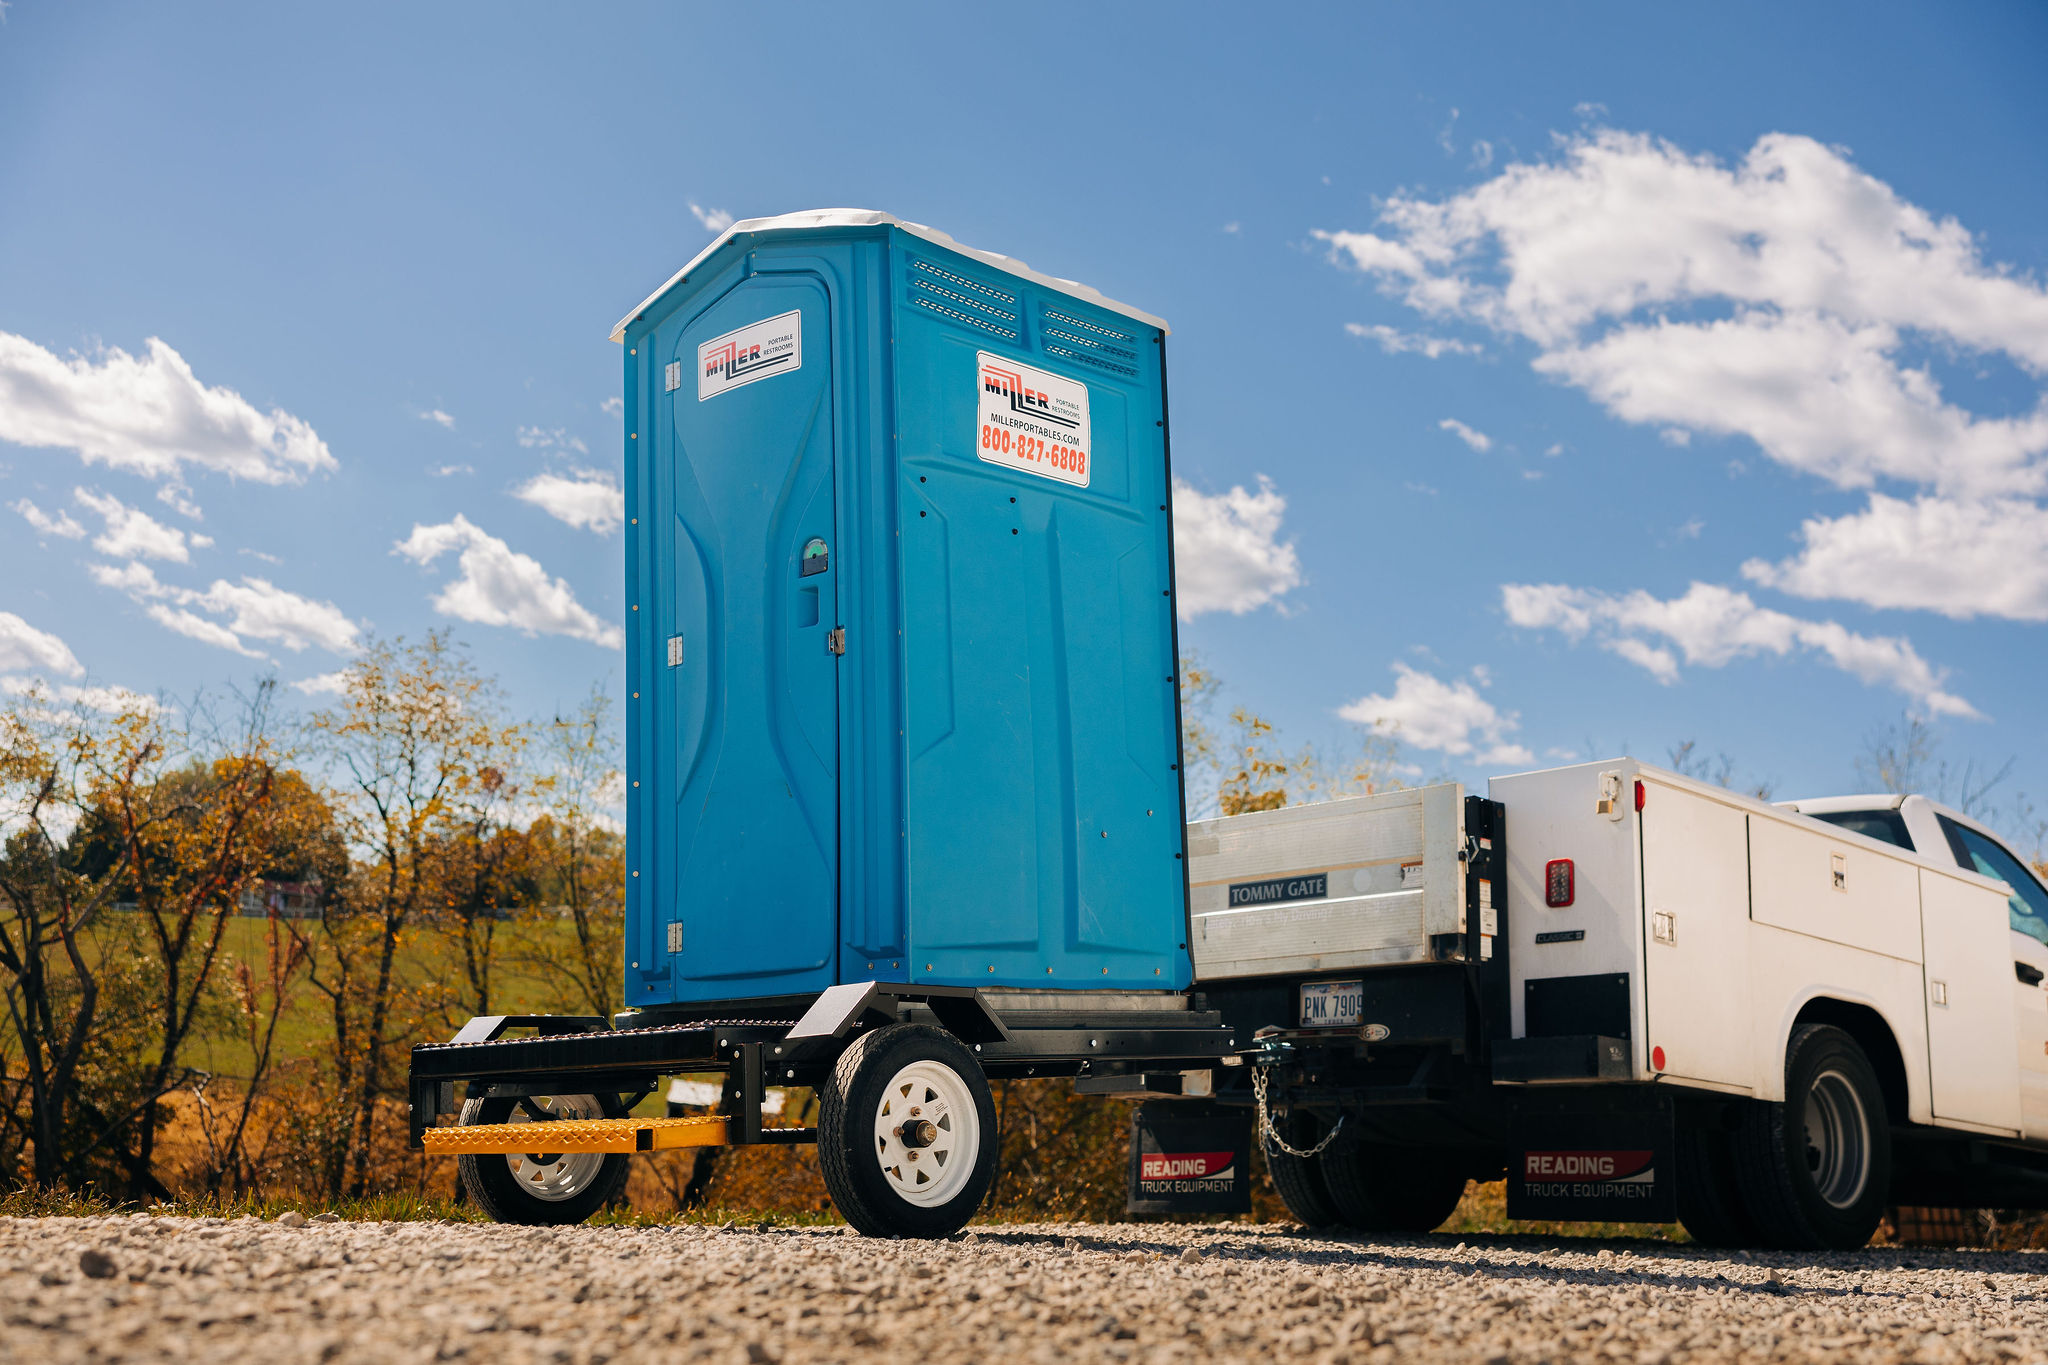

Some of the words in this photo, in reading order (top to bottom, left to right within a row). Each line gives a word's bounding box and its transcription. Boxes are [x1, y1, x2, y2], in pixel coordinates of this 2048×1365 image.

[763, 342, 793, 355] RESTROOMS
[768, 334, 793, 346] PORTABLE
[705, 341, 761, 381] MILLER
[984, 374, 1050, 411] MILLER
[1051, 405, 1080, 419] RESTROOMS
[1055, 398, 1080, 411] PORTABLE
[990, 413, 1080, 446] MILLERPORTABLES.COM
[982, 424, 1086, 475] 800-827-6808
[1232, 883, 1284, 903] TOMMY
[1288, 879, 1324, 896] GATE
[1304, 996, 1327, 1018] PNK
[1333, 994, 1363, 1017] 7909
[1142, 1158, 1207, 1178] READING
[1527, 1156, 1614, 1175] READING
[1140, 1180, 1173, 1193] TRUCK
[1175, 1180, 1235, 1193] EQUIPMENT
[1525, 1183, 1570, 1197] TRUCK
[1573, 1184, 1655, 1198] EQUIPMENT
